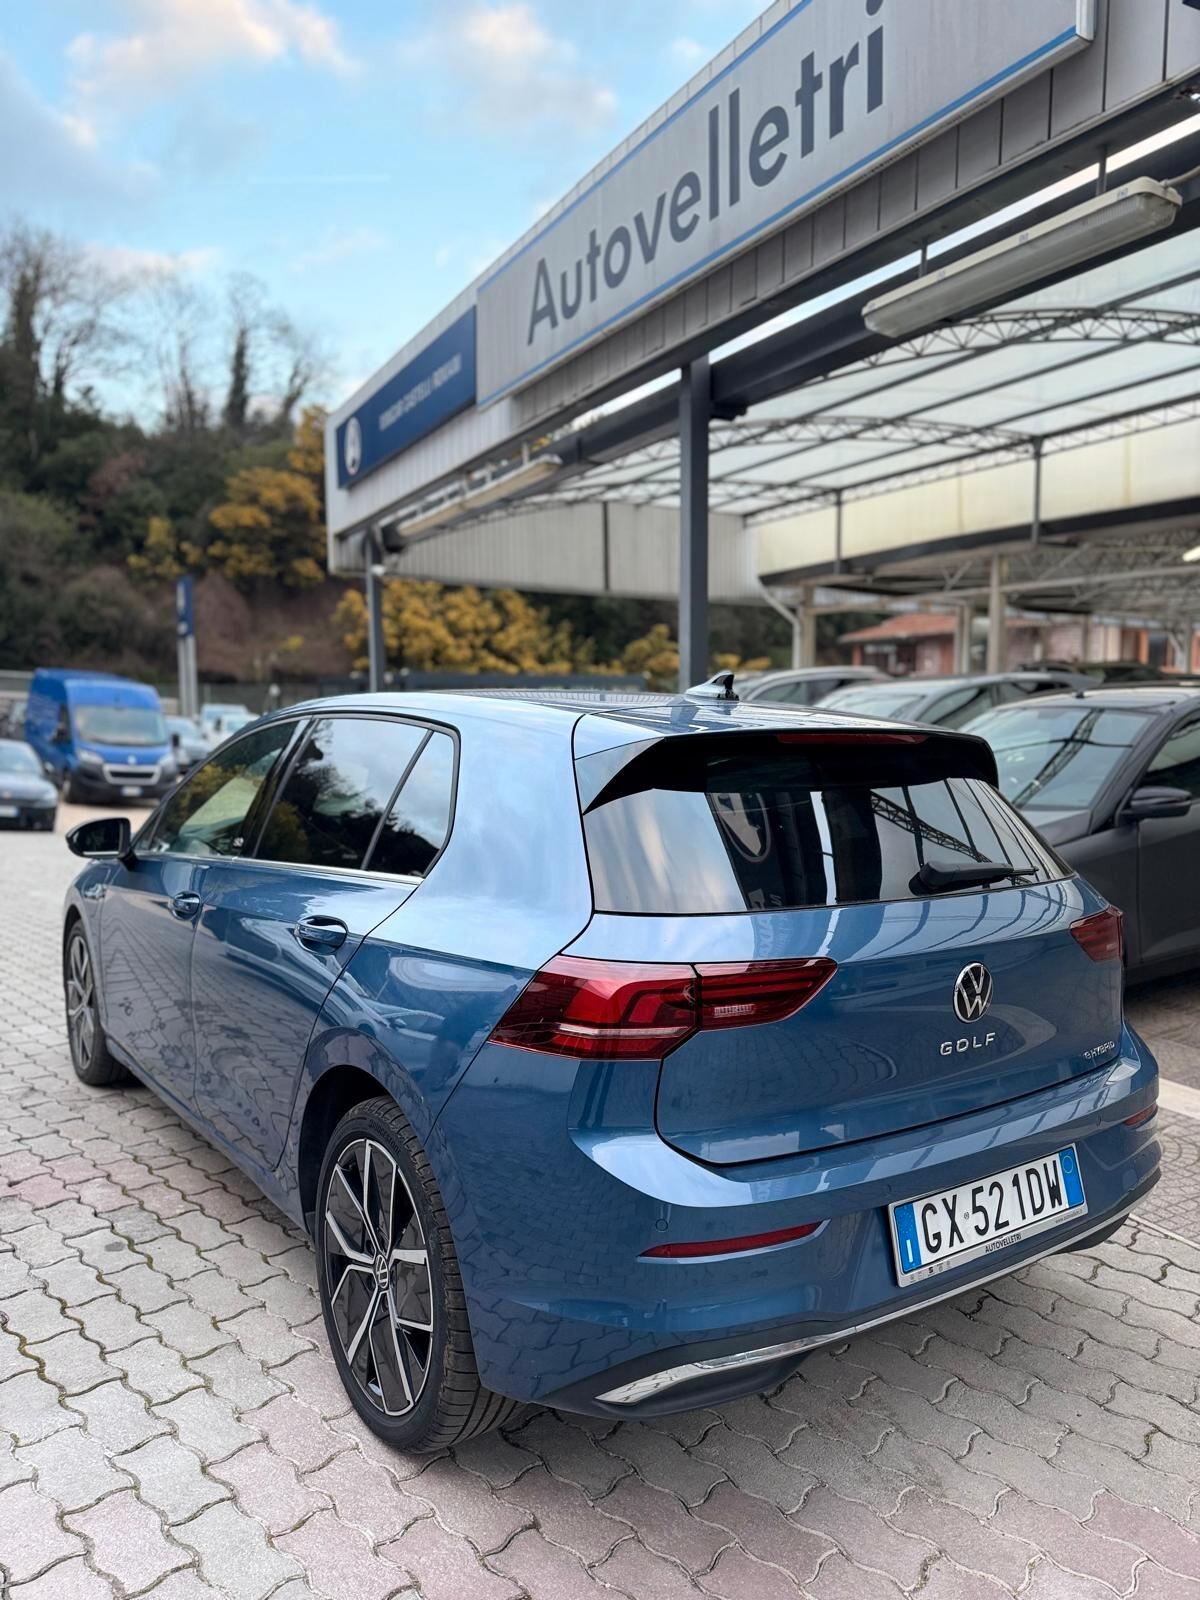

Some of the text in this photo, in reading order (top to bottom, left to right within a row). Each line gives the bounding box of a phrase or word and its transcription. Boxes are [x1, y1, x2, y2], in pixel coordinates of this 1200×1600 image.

[528, 0, 884, 345] Autovelletri
[940, 1032, 996, 1056] GOLF
[985, 1233, 1021, 1254] AUTOVELLETRI
